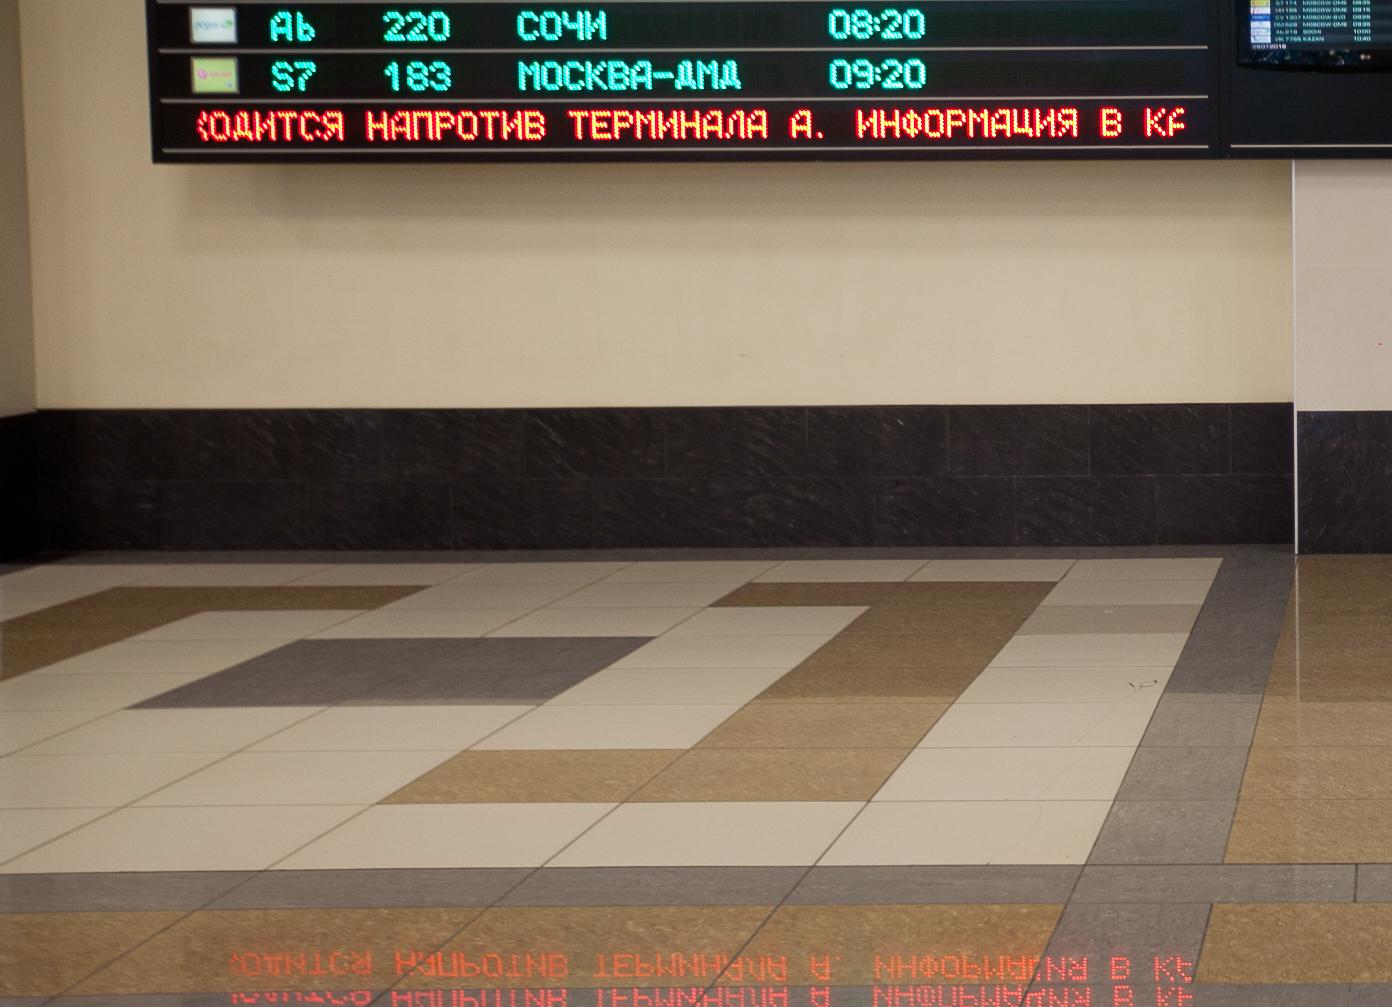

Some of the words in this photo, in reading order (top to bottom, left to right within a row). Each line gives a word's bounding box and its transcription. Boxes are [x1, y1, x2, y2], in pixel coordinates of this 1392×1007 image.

[383, 11, 451, 42] 220
[517, 10, 608, 42] СОЧИ
[829, 9, 926, 40] 08:20
[272, 61, 317, 92] S7
[384, 61, 452, 92] 183
[518, 59, 742, 91] МОСКВА-ДМД
[829, 58, 927, 89] 09:20
[366, 110, 547, 141] НАПРОТИВ
[566, 109, 769, 141] ТЕРМИНАЛА
[789, 109, 825, 140] А.
[855, 107, 1079, 139] ИНФОРМАЦИЯ
[1099, 106, 1123, 138] В
